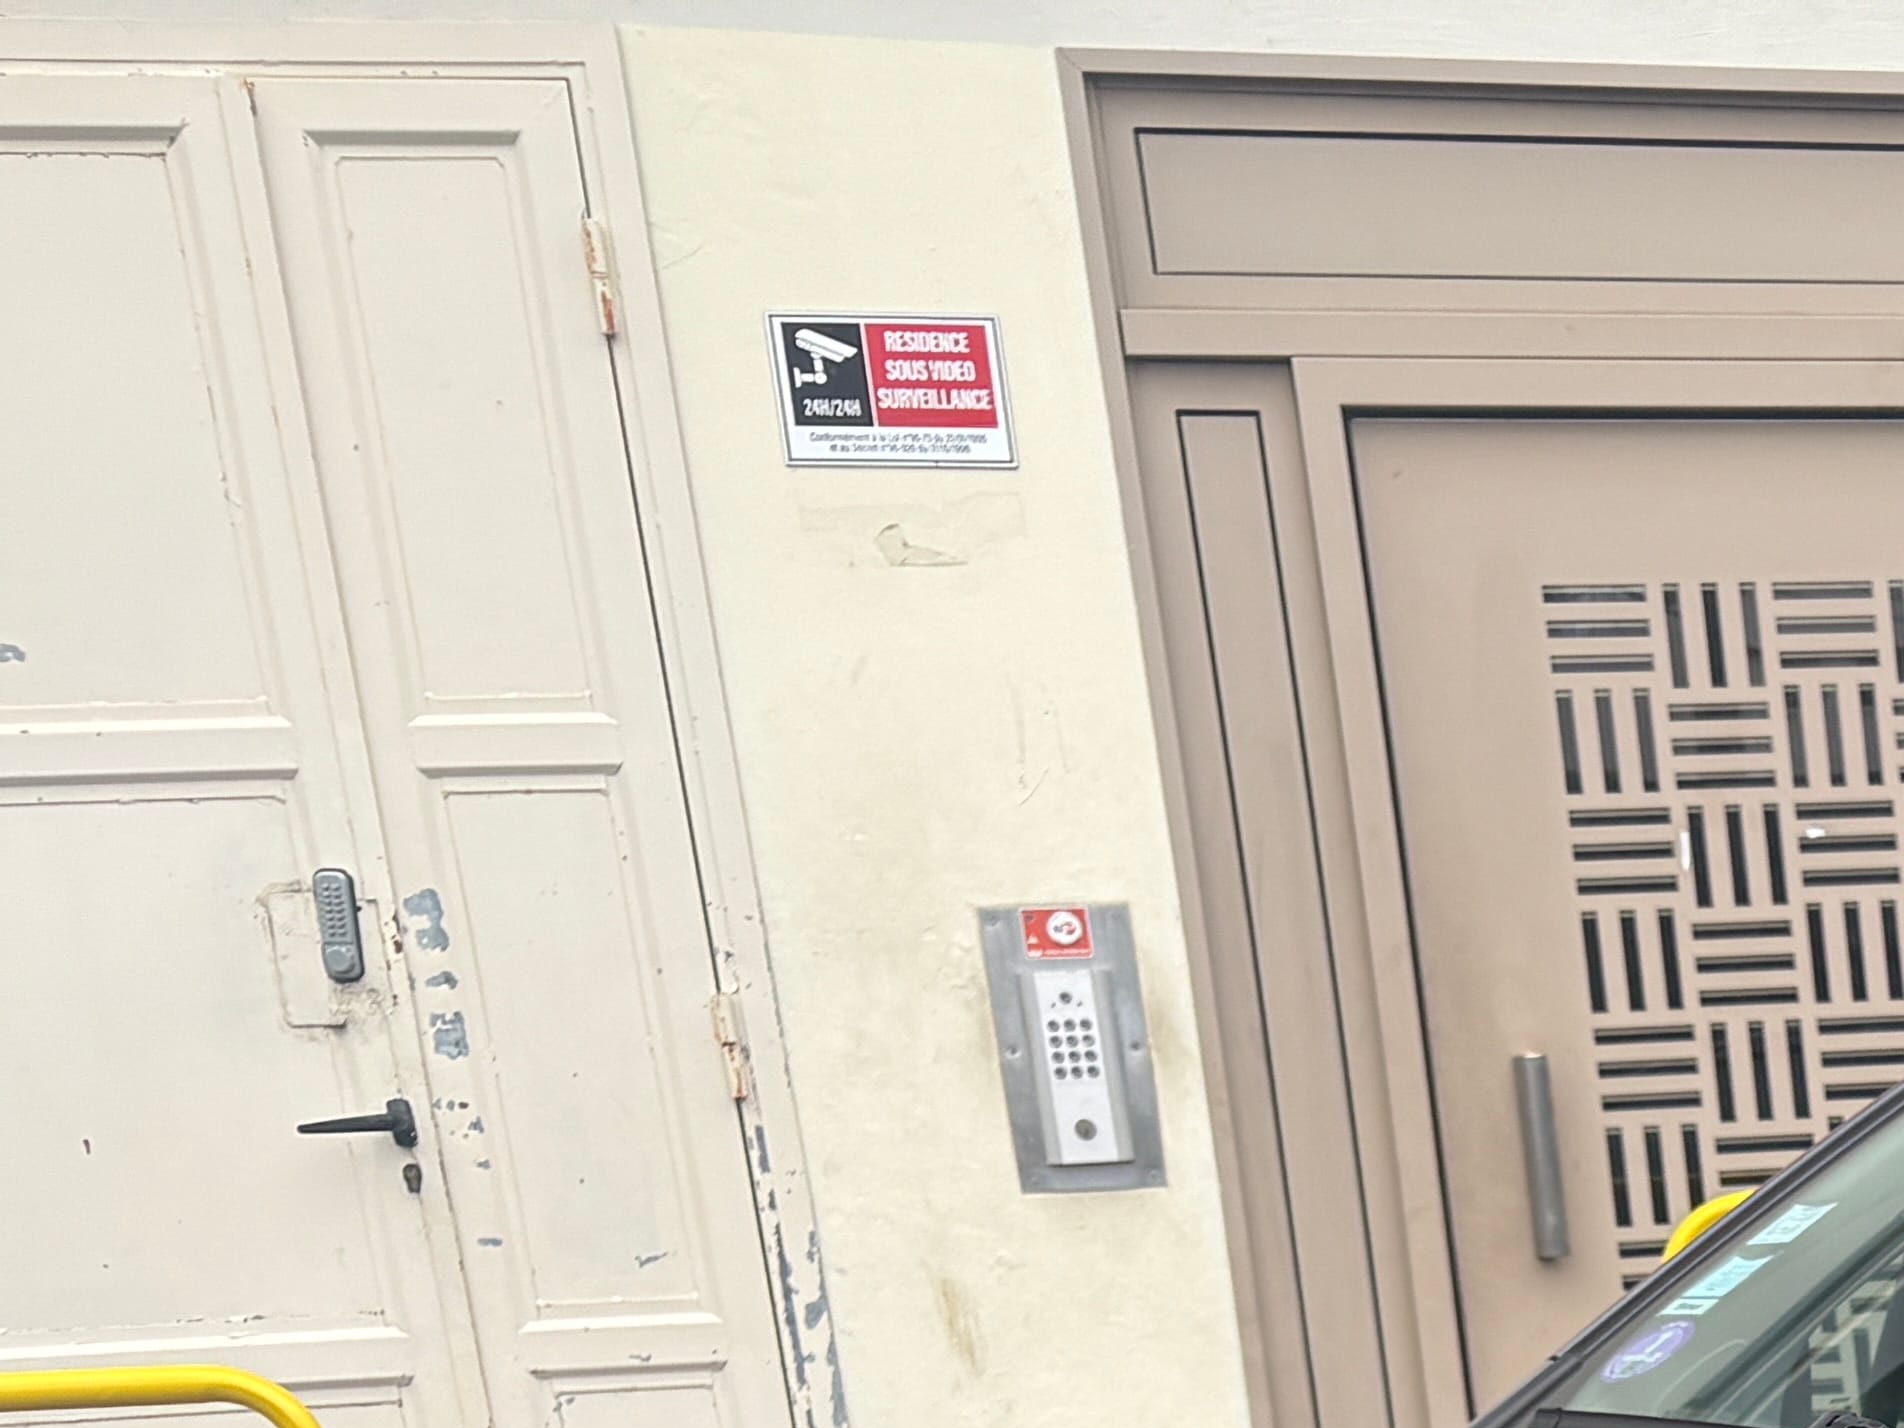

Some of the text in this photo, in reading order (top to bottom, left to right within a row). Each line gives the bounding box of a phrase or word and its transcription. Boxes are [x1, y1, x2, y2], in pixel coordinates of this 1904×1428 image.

[883, 330, 970, 353] RESIDENCE
[884, 359, 976, 382] SOUS VIDEO
[877, 387, 993, 410] SURVEILLANCE
